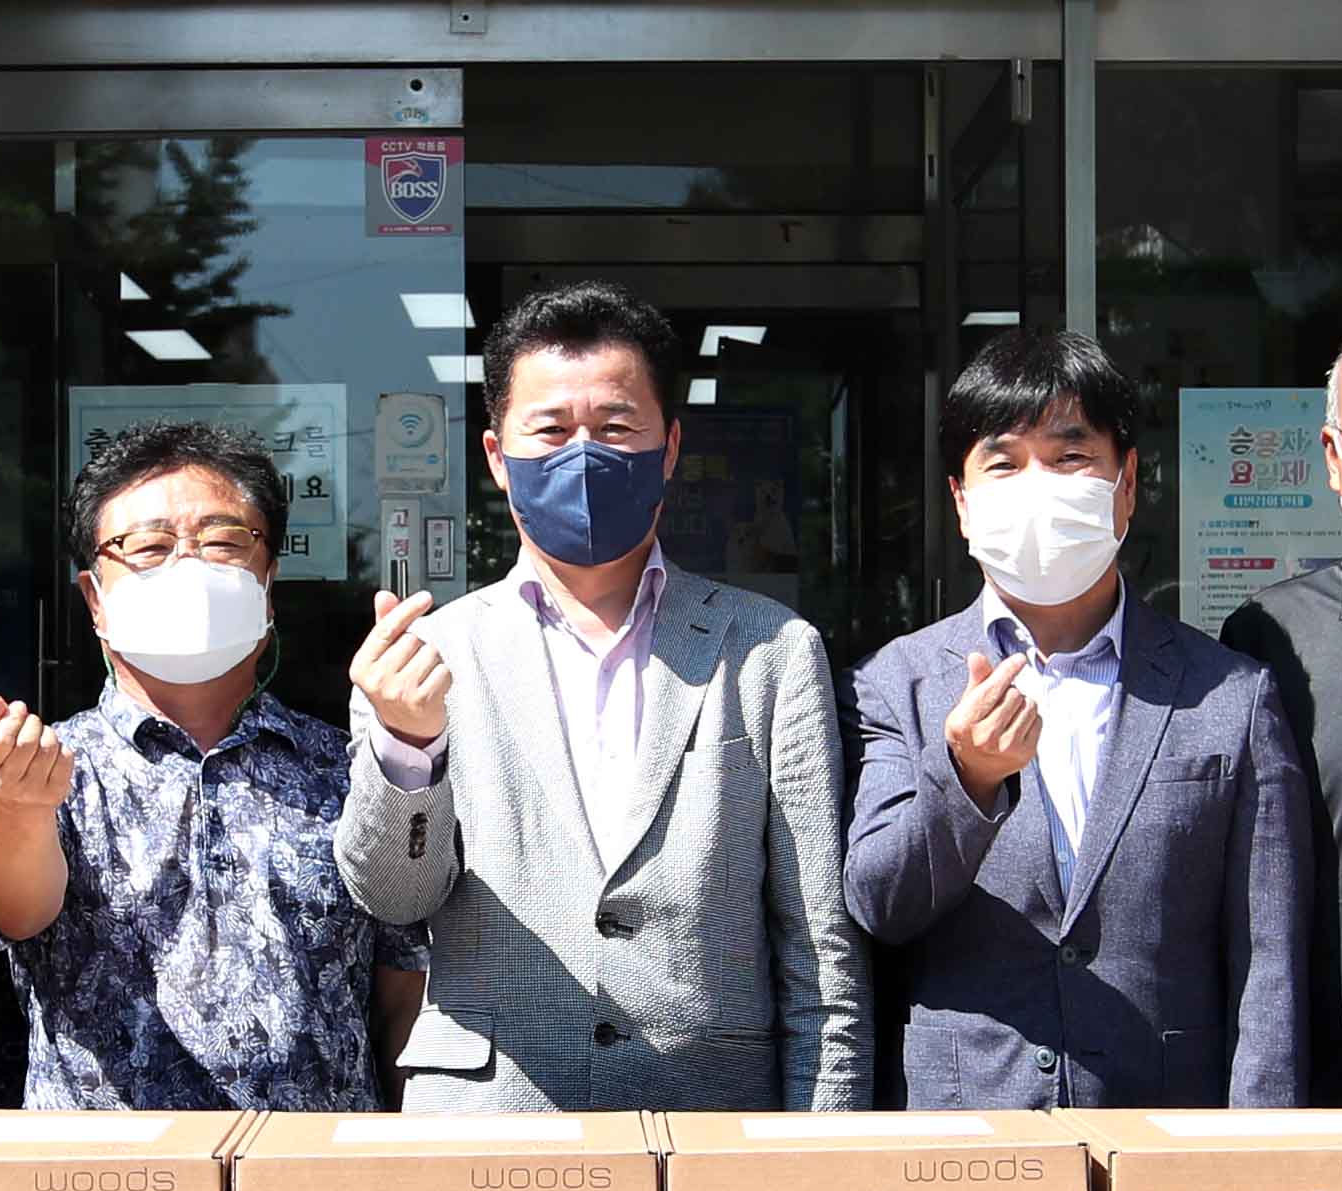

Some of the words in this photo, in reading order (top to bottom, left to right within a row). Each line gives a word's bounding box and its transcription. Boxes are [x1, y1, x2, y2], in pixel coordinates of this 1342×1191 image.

[380, 141, 412, 153] CCTV
[390, 181, 439, 199] BOSS
[1229, 426, 1309, 456] 승용차
[1229, 460, 1310, 489] 요일제
[470, 1163, 611, 1189] woods
[902, 1156, 1043, 1183] woods
